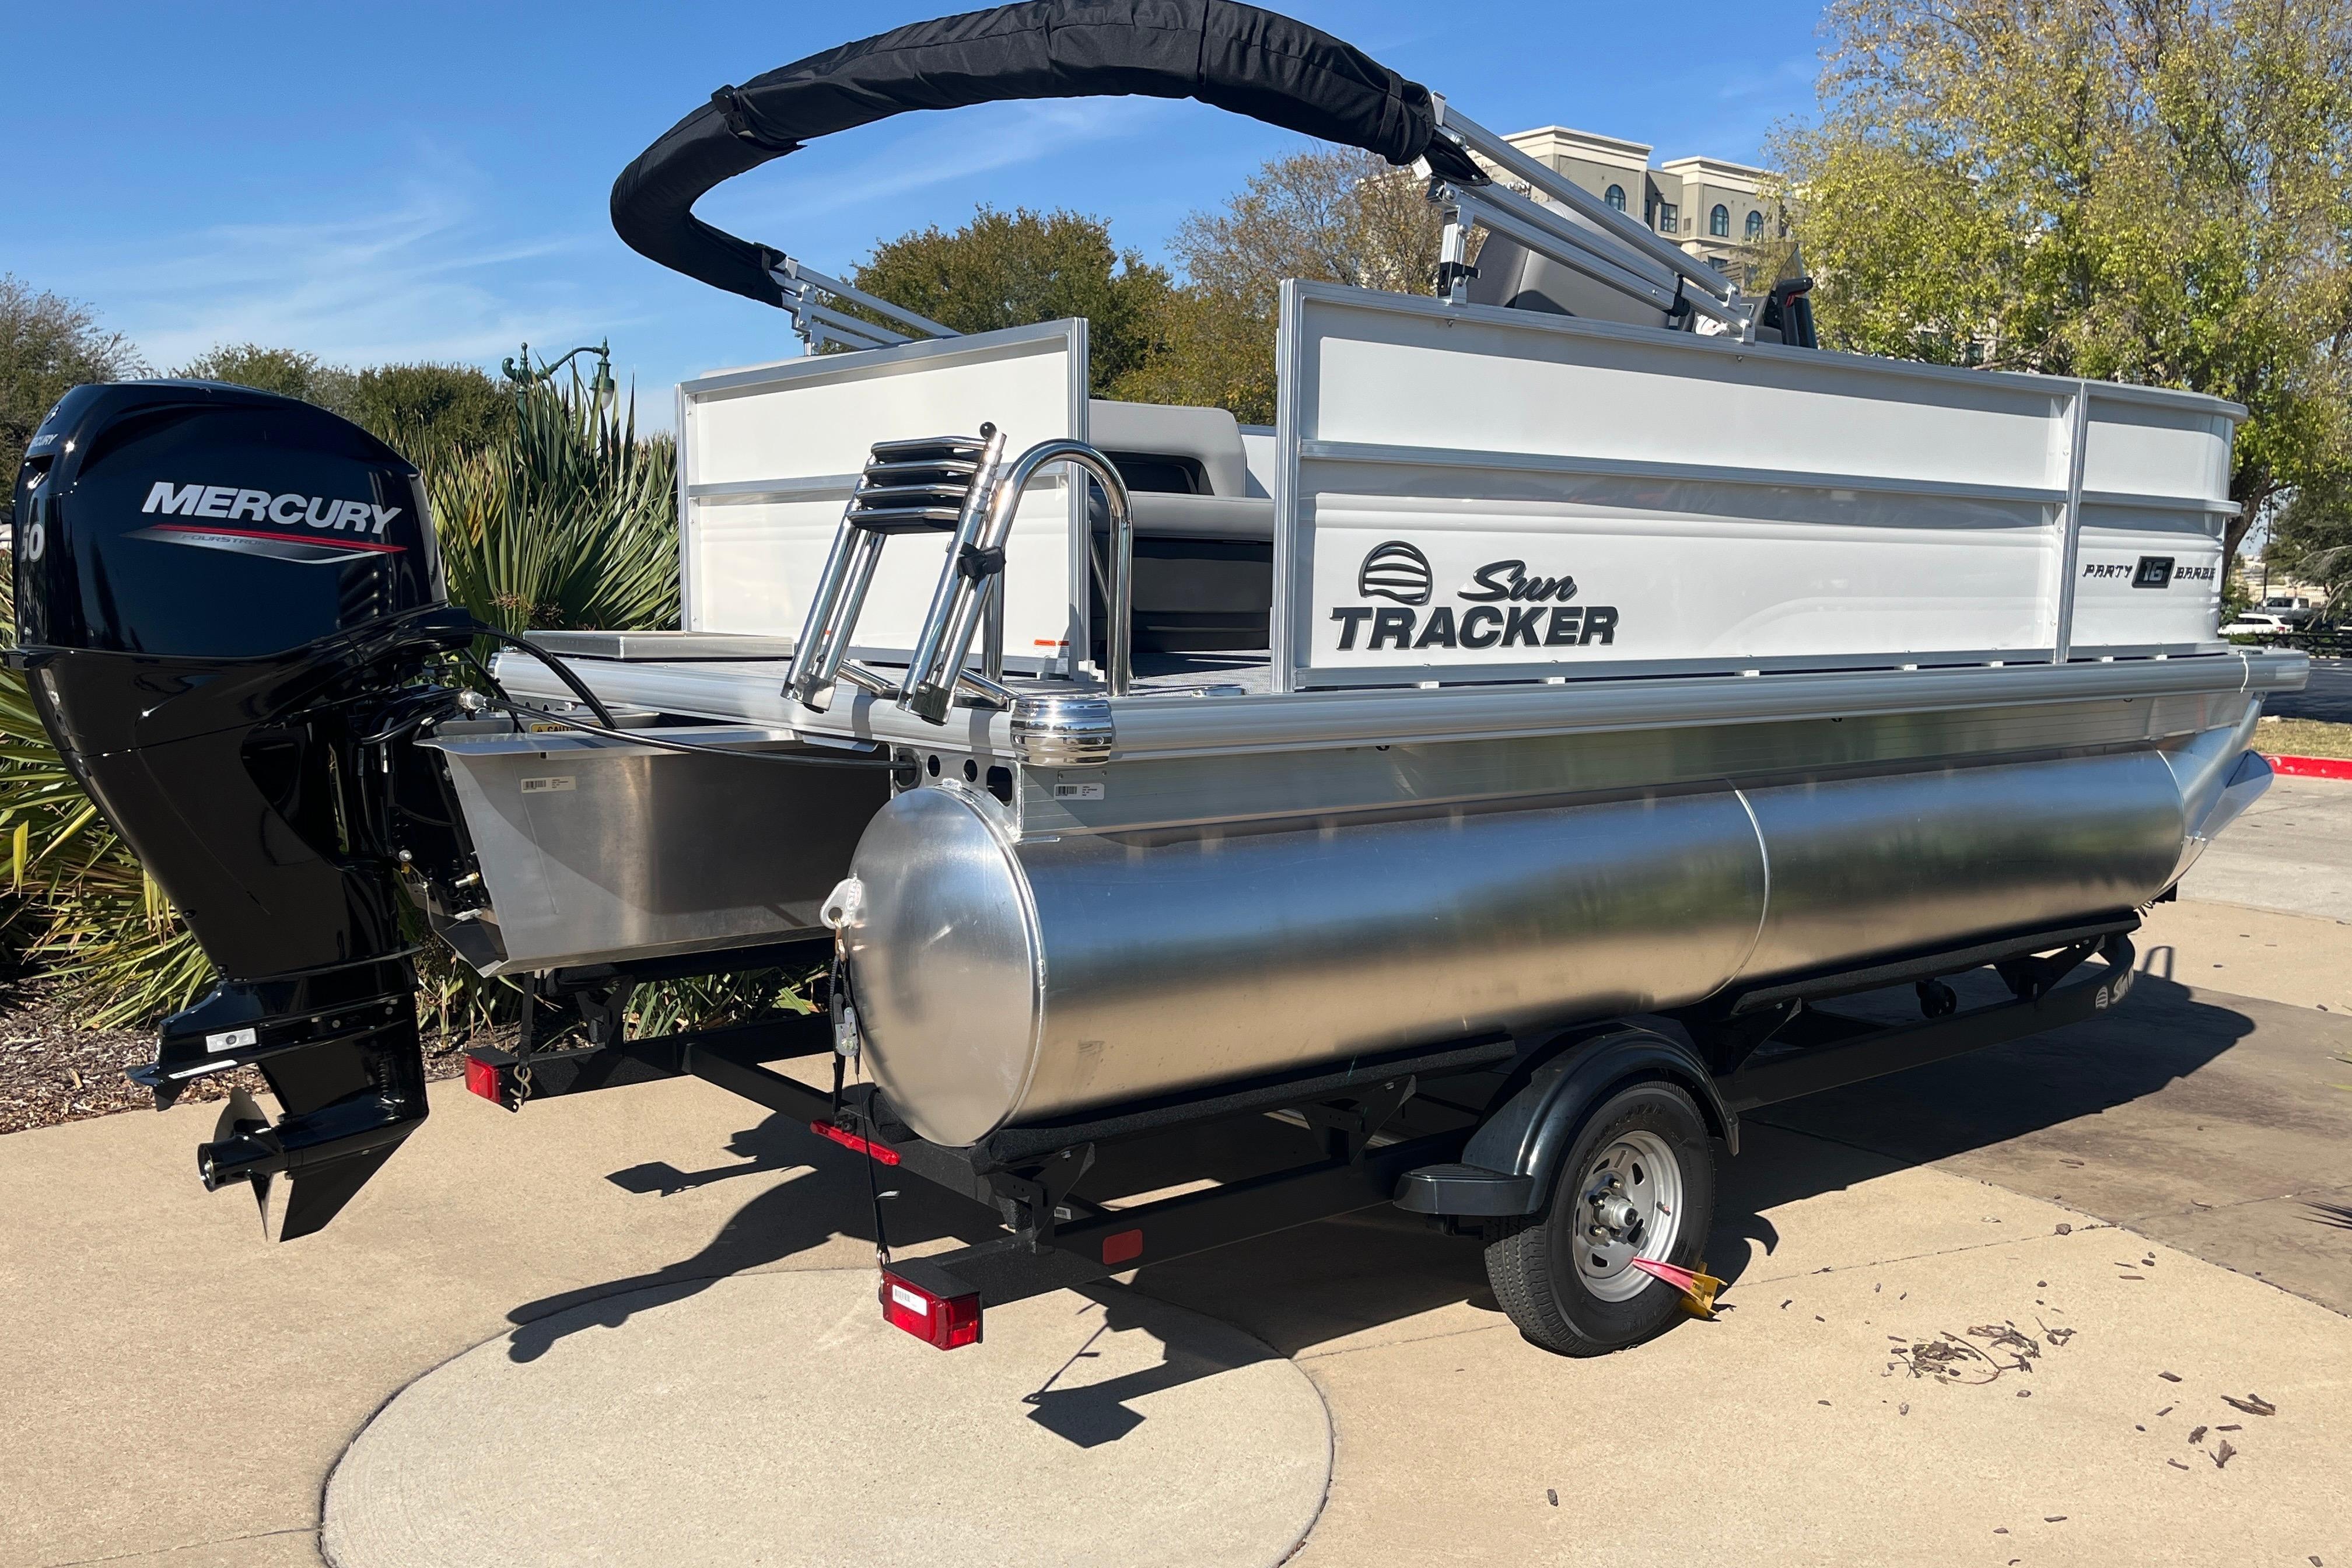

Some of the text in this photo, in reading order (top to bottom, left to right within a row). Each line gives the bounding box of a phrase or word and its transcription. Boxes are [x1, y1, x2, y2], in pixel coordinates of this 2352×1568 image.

[30, 433, 58, 448] CURY
[141, 481, 402, 534] MERCURY
[180, 533, 278, 547] FOURSTROKE
[1457, 559, 1578, 602] Sun
[2081, 561, 2216, 582] PARTY 16 BARGE
[1329, 605, 1619, 650] TRACKER
